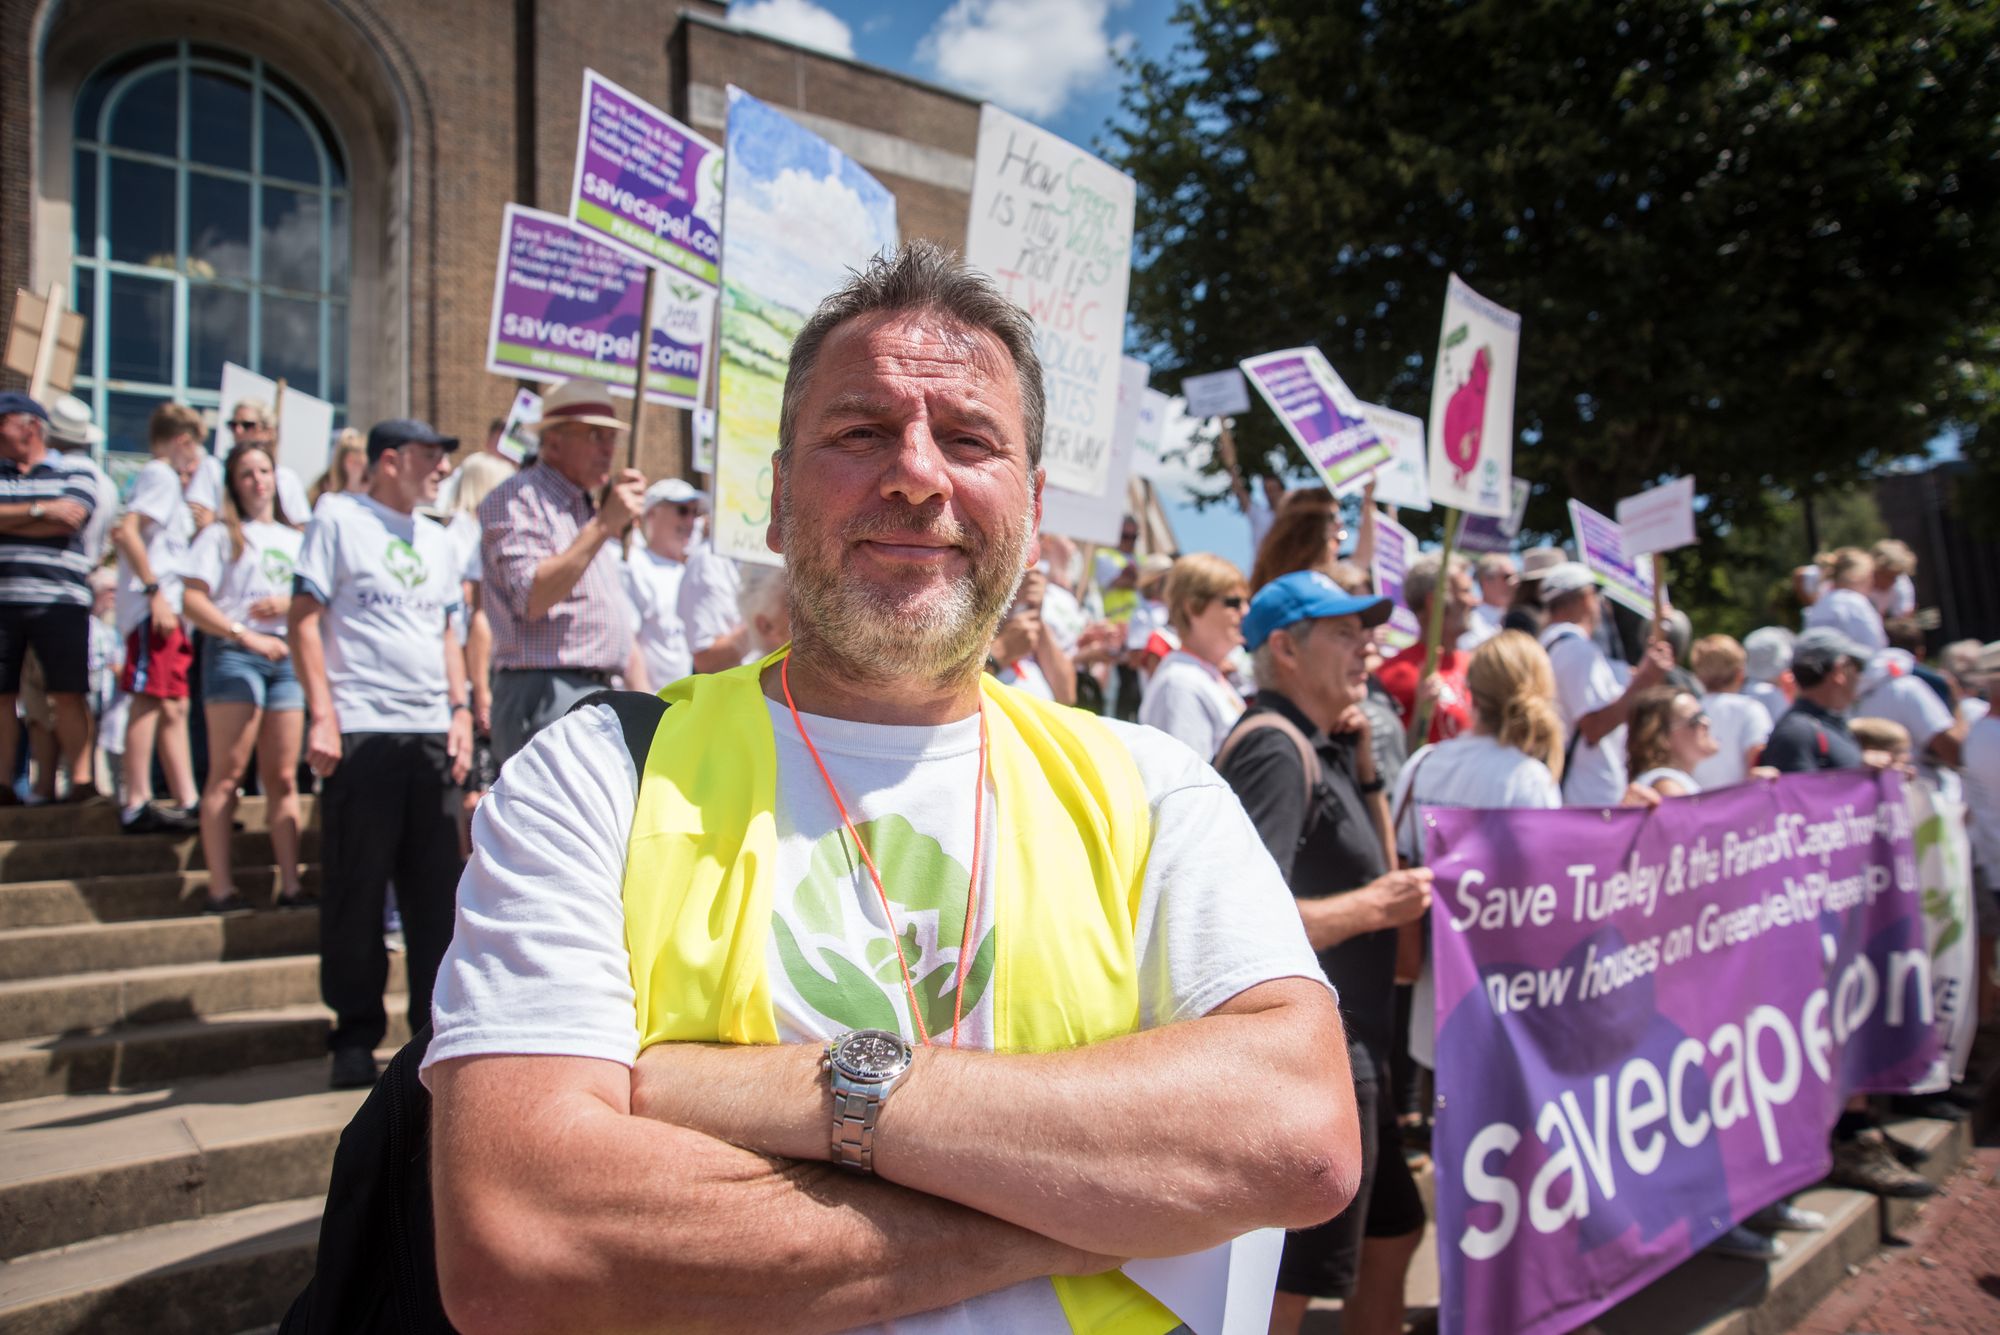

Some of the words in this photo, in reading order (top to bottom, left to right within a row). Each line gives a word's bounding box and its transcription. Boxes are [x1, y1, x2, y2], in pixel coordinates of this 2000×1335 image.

[583, 172, 718, 256] savecapel.co
[508, 270, 547, 291] Please
[1451, 869, 1557, 932] Save
[1566, 850, 1665, 917] Tueley
[1664, 844, 1687, 896] &
[1486, 966, 1574, 1014] new
[1578, 944, 1661, 1001] houses
[1663, 925, 1693, 965] on
